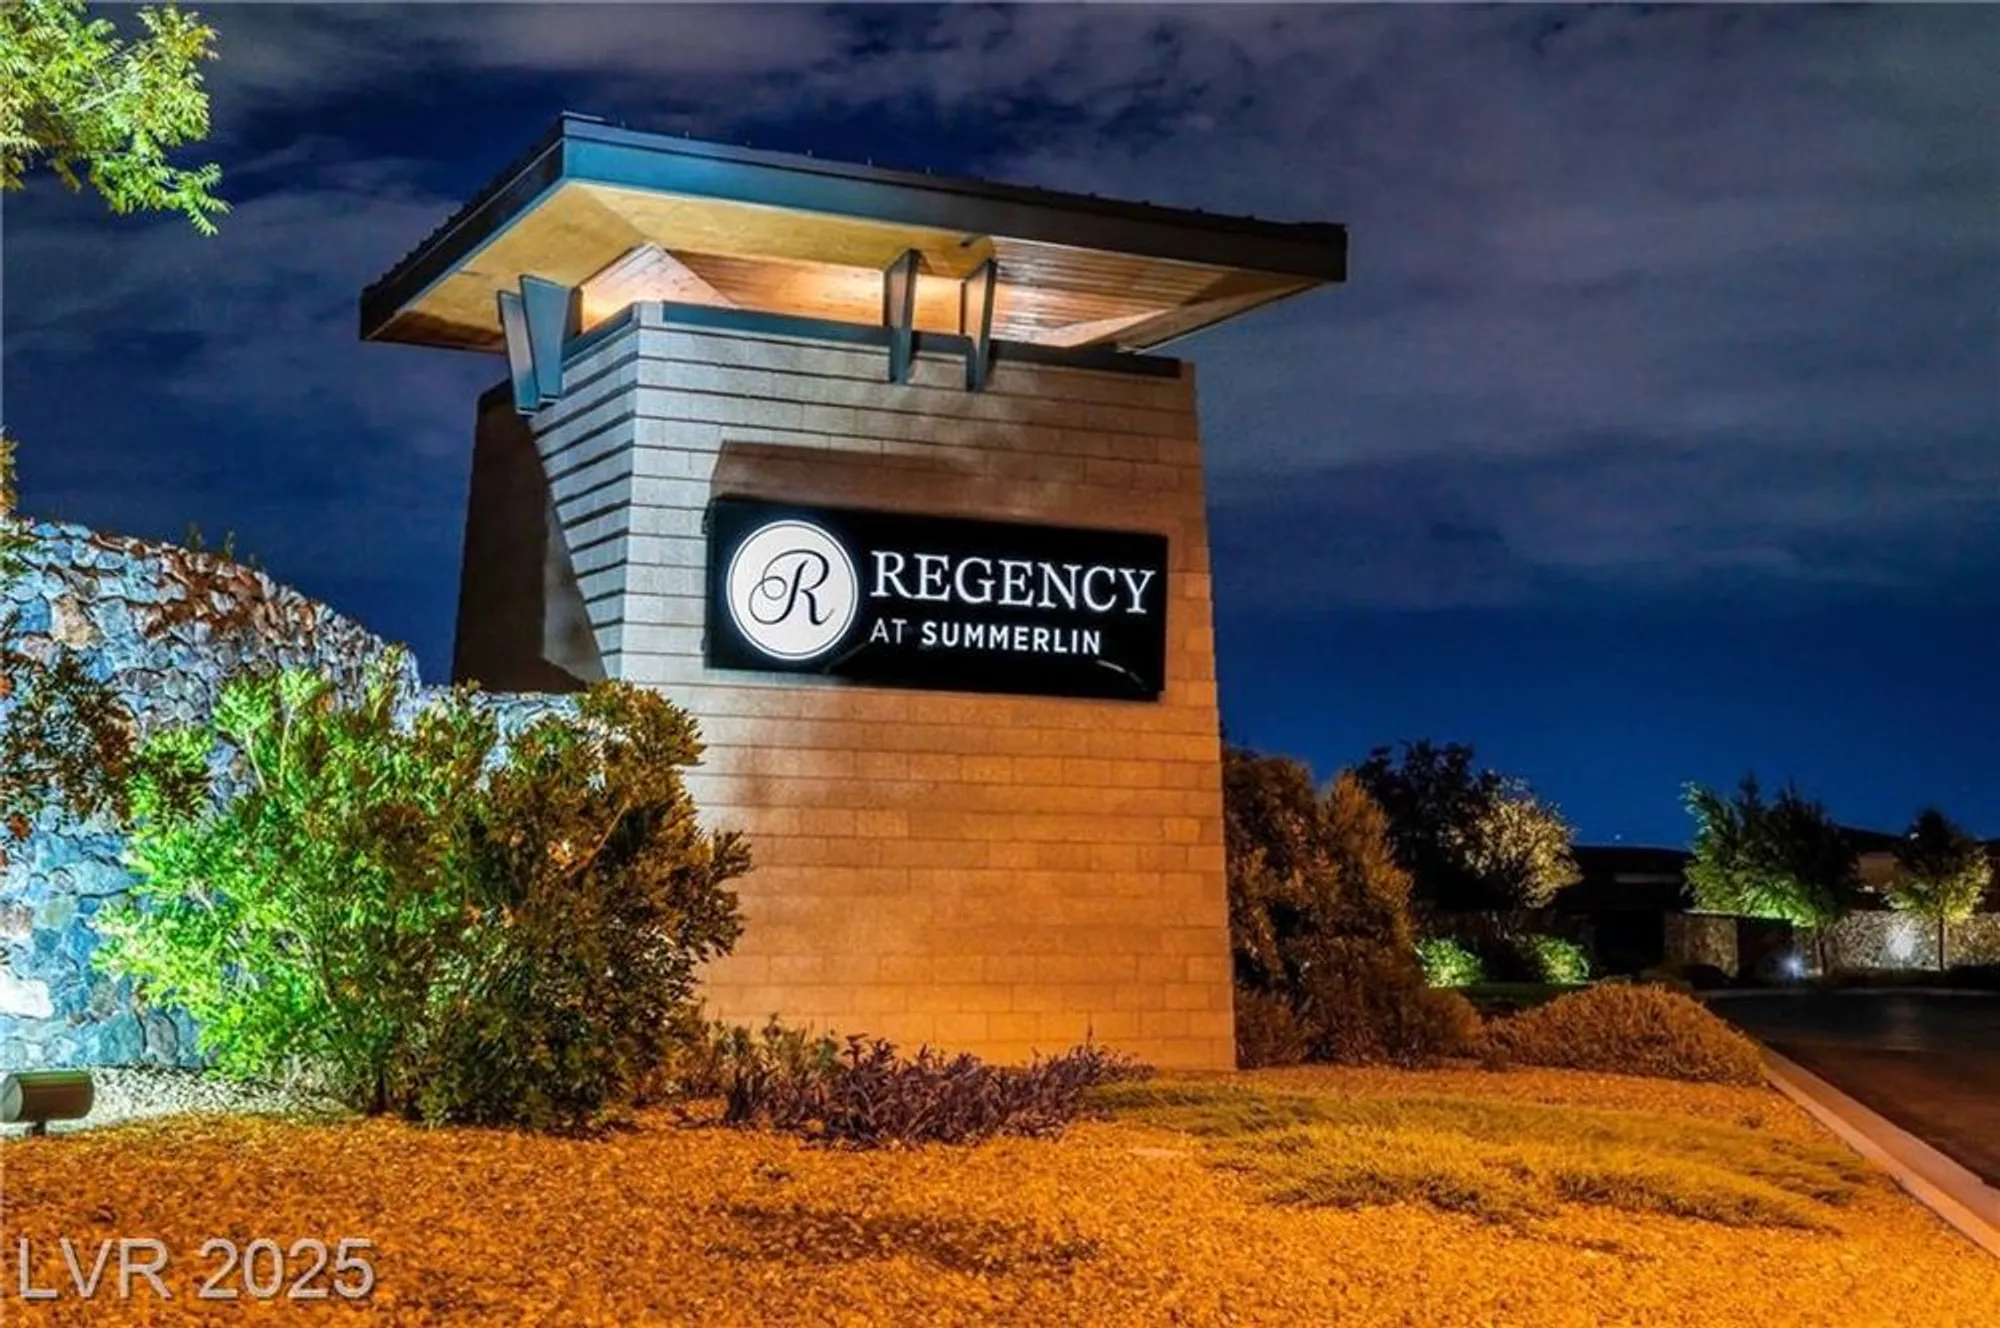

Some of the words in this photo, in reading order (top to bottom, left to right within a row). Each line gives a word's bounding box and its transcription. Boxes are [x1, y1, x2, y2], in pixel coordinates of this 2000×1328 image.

[748, 549, 835, 626] R
[869, 550, 1156, 614] REGENCY
[870, 619, 907, 644] AT
[921, 621, 1101, 655] SUMMERLIN
